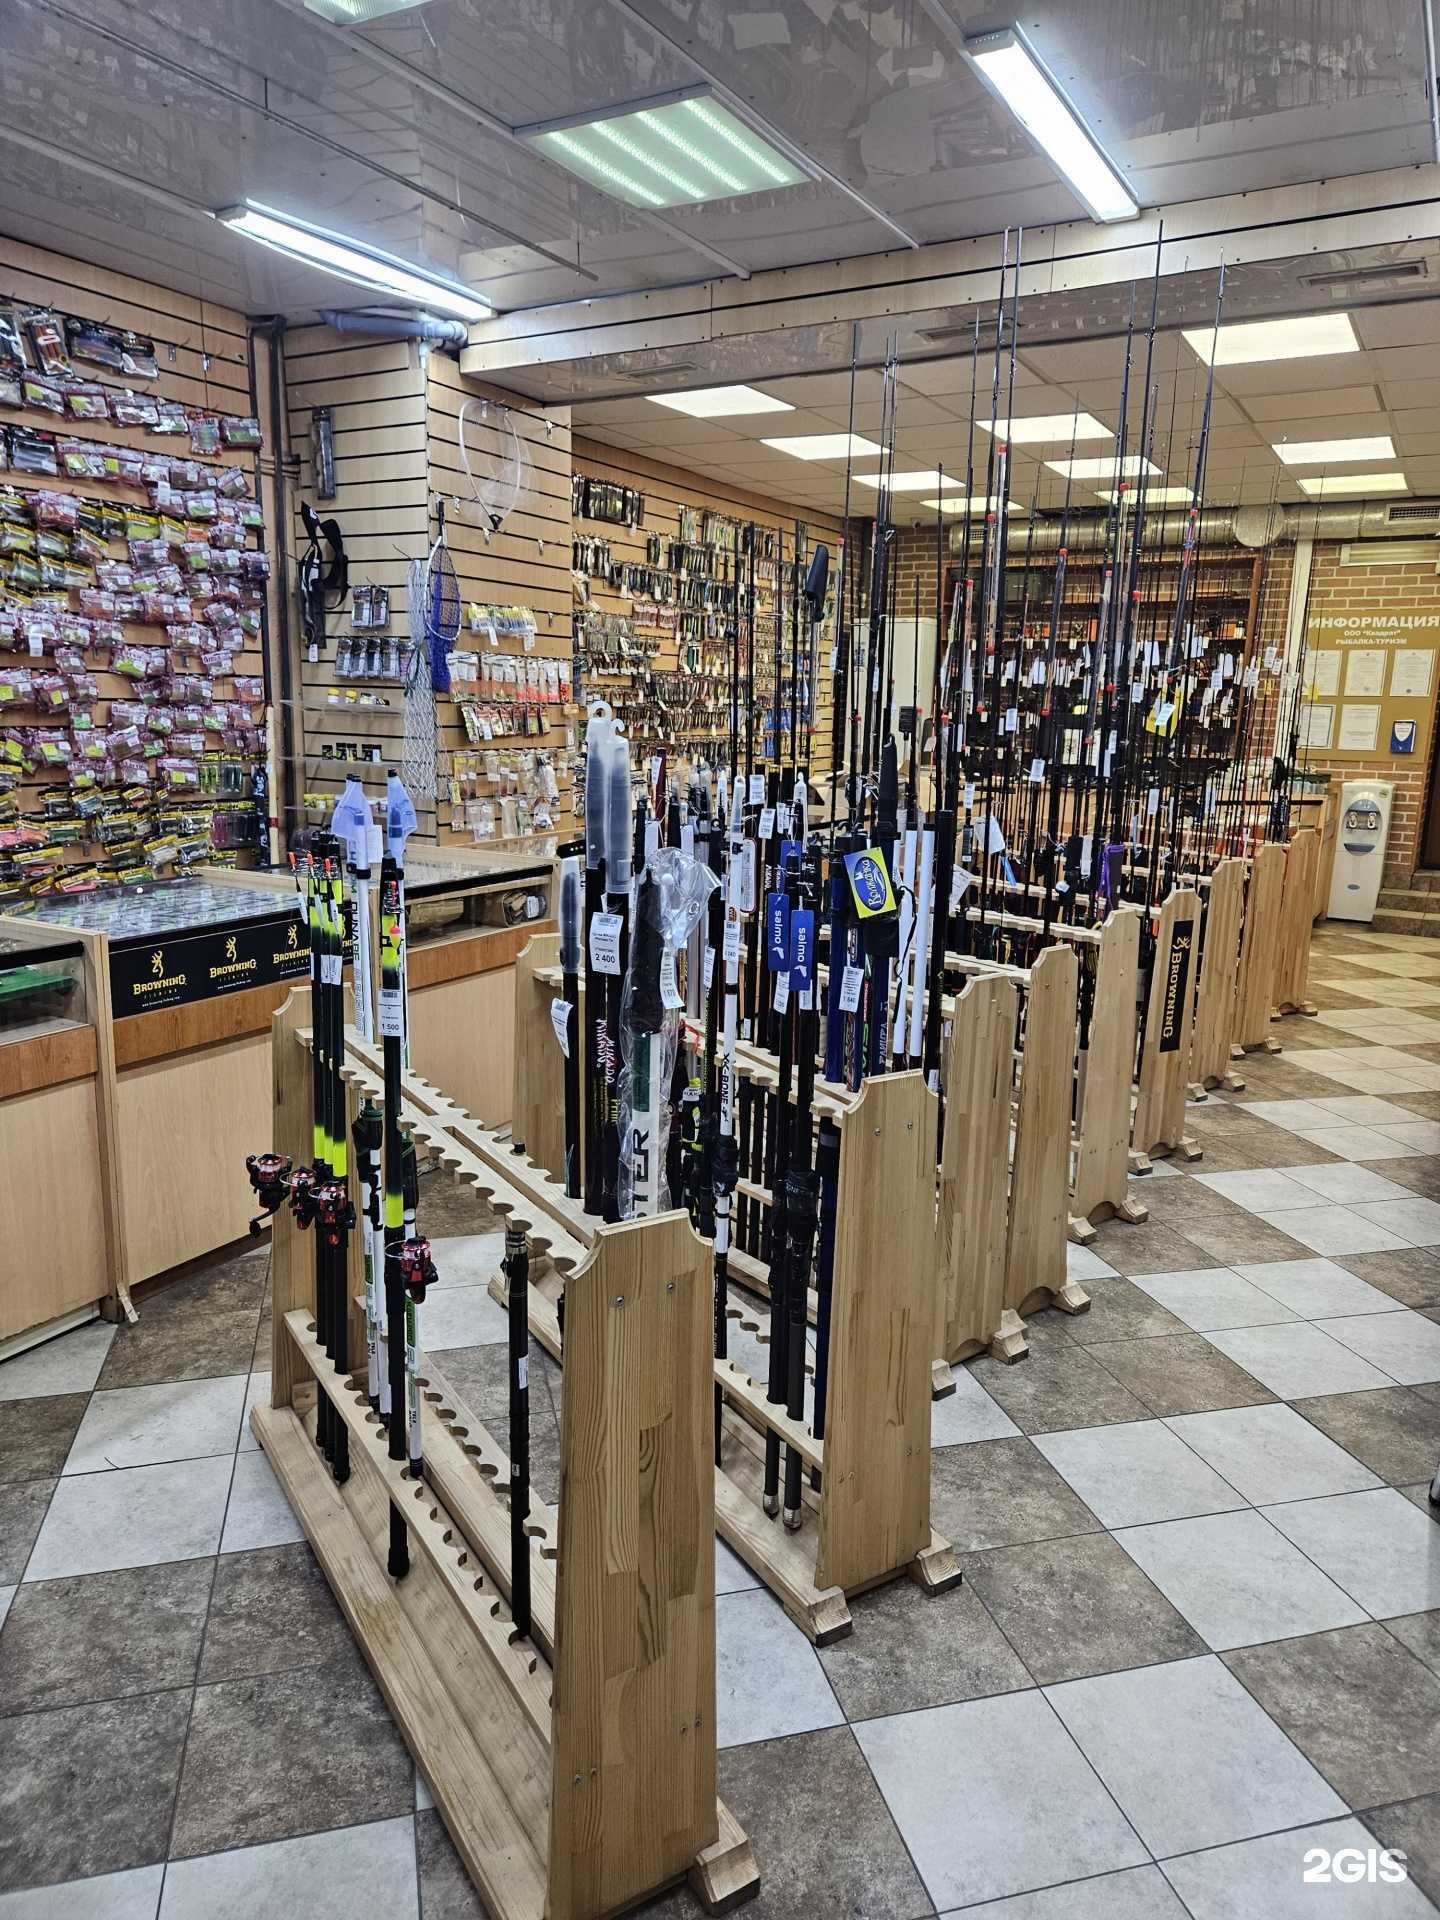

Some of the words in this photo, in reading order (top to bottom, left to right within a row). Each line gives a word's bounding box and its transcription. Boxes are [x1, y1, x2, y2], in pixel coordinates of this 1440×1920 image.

[1308, 615, 1440, 629] ИНФОРМАЦИЯ
[774, 910, 783, 944] salmo
[797, 927, 807, 962] salmo
[272, 946, 312, 964] BROWNIN
[595, 953, 600, 961] 2
[602, 954, 616, 963] 400
[209, 958, 257, 978] BROWNING
[133, 974, 187, 995] BROWNING
[1163, 952, 1182, 1038] BROWNING
[386, 1023, 400, 1031] 500
[605, 1036, 616, 1083] MIKADO
